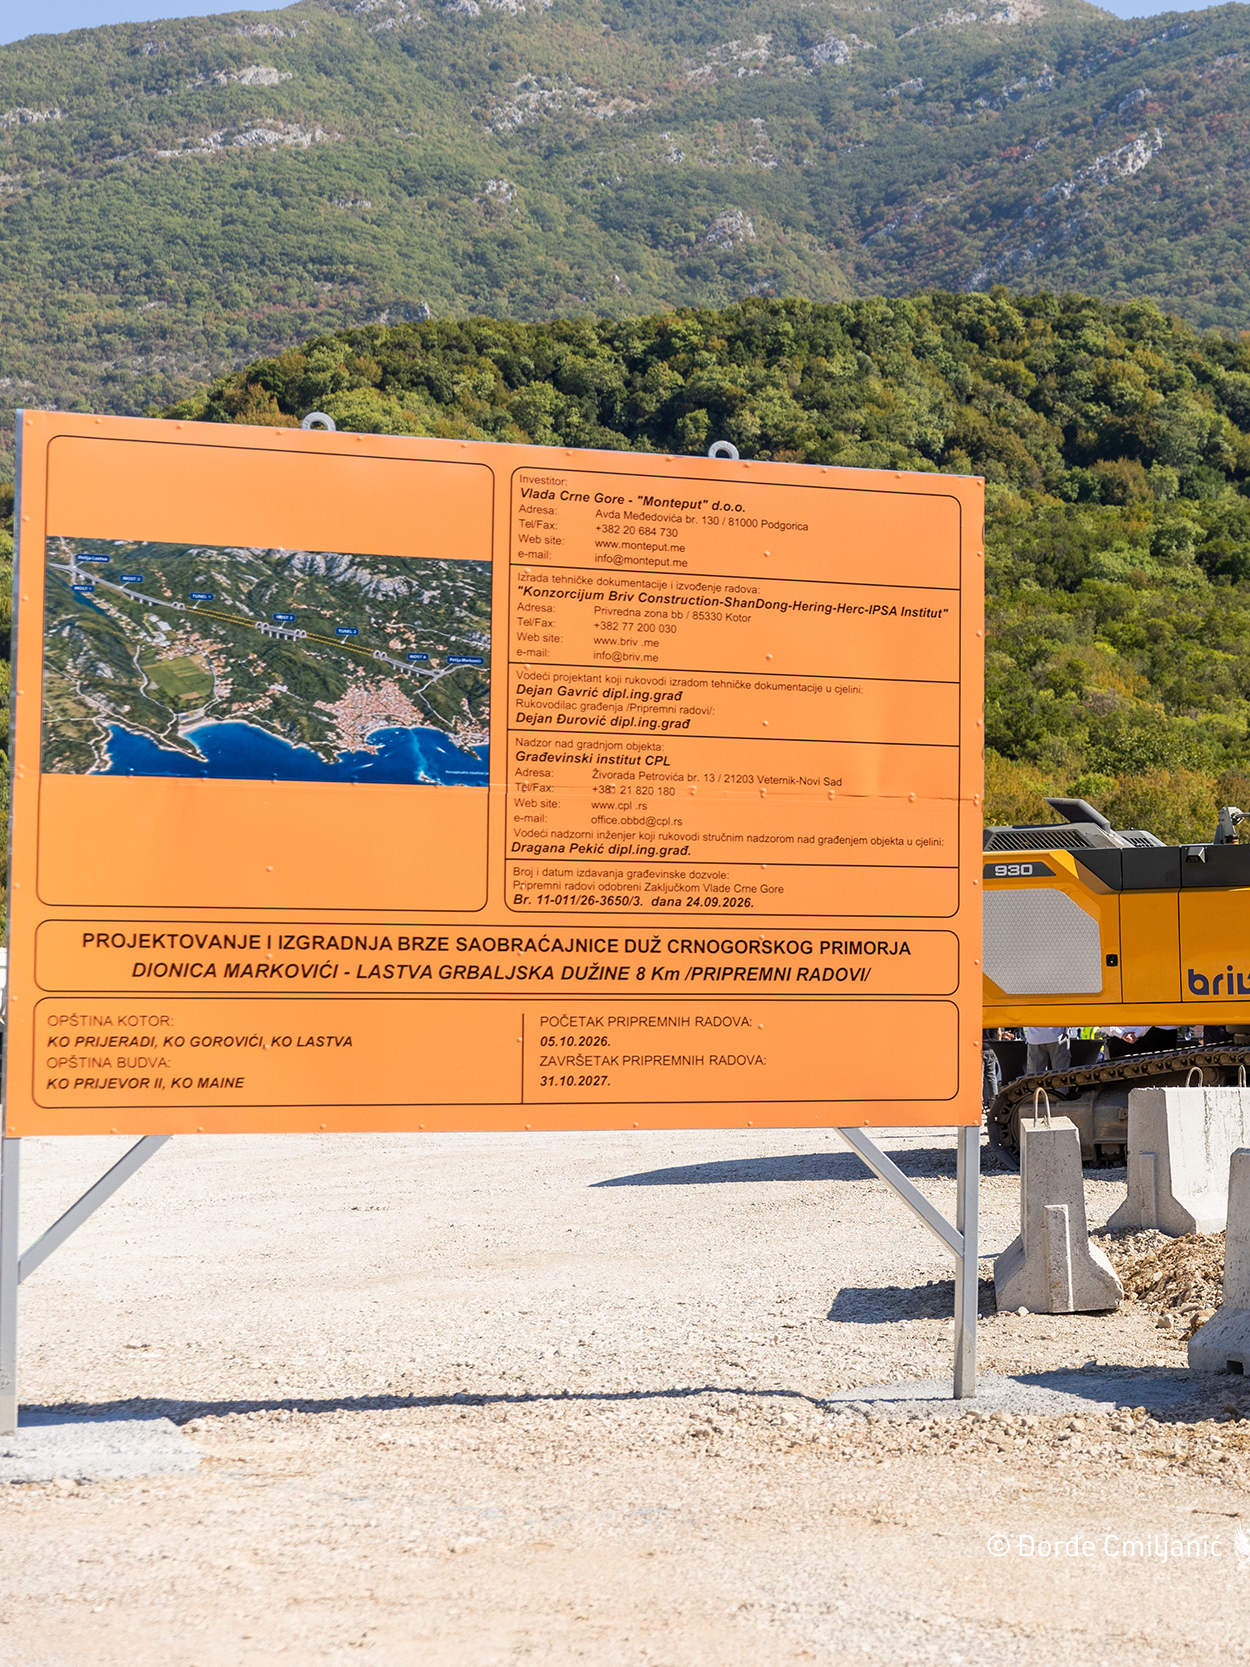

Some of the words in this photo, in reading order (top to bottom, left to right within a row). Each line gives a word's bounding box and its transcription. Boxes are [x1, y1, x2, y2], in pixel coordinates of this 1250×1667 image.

[519, 473, 567, 486] Investitor:
[520, 487, 555, 500] Vlada
[559, 489, 590, 503] Crne
[593, 492, 625, 505] Gore
[637, 494, 708, 511] "Monteput"
[711, 500, 745, 512] d.o.o.
[518, 503, 557, 515] Adresa:
[594, 508, 620, 519] Avda
[623, 510, 682, 523] Međedovića
[685, 514, 698, 524] br.
[701, 515, 720, 526] 130
[721, 516, 726, 526] /
[727, 516, 758, 528] 81000
[760, 518, 808, 532] Podgorica
[518, 518, 557, 530] Tel/Fax:
[595, 523, 620, 534] +382
[622, 524, 636, 535] 20
[637, 525, 656, 536] 684
[659, 526, 678, 538] 730
[517, 533, 542, 544] Web
[543, 536, 564, 546] site:
[594, 540, 685, 553] www.monteput.me
[517, 550, 551, 559] e-mail:
[594, 553, 688, 568] info@monteput.me
[517, 585, 604, 602] "Konzorcijum
[607, 590, 634, 602] Briv
[637, 591, 897, 616] Construction-ShanDong-Hering-Herc-IPSA
[900, 605, 949, 618] Institut"
[593, 605, 641, 617] Privredna
[643, 609, 668, 619] zona
[670, 609, 684, 620] bb
[685, 610, 690, 619] /
[691, 610, 722, 622] 85330
[724, 612, 752, 623] Kotor
[593, 620, 619, 631] +382
[621, 621, 634, 631] 77
[636, 622, 656, 633] 200
[658, 623, 677, 634] 030
[592, 636, 638, 646] www.briv
[641, 639, 659, 648] .me
[592, 650, 659, 663] info@briv.me
[515, 683, 553, 698] Dejan
[556, 685, 599, 698] Gavrić
[601, 687, 683, 703] dipl.ing.građ
[515, 697, 577, 710] Rukovodilac
[579, 701, 623, 714] građenja
[625, 702, 676, 714] /Pripremni
[679, 705, 715, 715] radovi/:
[515, 711, 553, 726] Dejan
[556, 713, 606, 726] Đurović
[609, 715, 691, 731] dipl.ing.građ
[515, 736, 552, 748] Nadzor
[554, 739, 573, 748] nad
[576, 740, 623, 752] gradnjom
[625, 741, 664, 753] objekta:
[515, 750, 593, 764] Građevinski
[595, 753, 641, 766] institut
[644, 754, 670, 766] CPL
[619, 784, 631, 795] 21
[634, 785, 654, 796] 820
[657, 786, 675, 796] 180
[590, 800, 632, 812] www.cpl
[635, 802, 648, 810] .rs
[590, 814, 683, 828] office.obbd@cpl.rs
[510, 841, 565, 856] Dragana
[568, 842, 604, 854] Pekić
[607, 843, 691, 858] dipl.ing.građ.
[994, 863, 1033, 877] 930
[512, 893, 531, 905] Br.
[536, 893, 643, 906] 11-011/26-3650/3.
[650, 895, 682, 907] dana
[685, 896, 754, 908] 24.09.2026.
[82, 932, 261, 950] PROJEKTOVANJE
[266, 934, 271, 950] I
[278, 934, 393, 951] IZGRADNJA
[397, 935, 449, 951] BRZE
[455, 933, 618, 953] SAOBRAĆAJNICE
[624, 934, 662, 953] DUŽ
[666, 938, 813, 955] CRNOGORSKOG
[819, 940, 911, 955] PRIMORJA
[131, 962, 216, 978] DIONICA
[223, 959, 338, 979] MARKOVIĆI
[355, 963, 432, 979] LASTVA
[438, 964, 554, 980] GRBALJSKA
[560, 961, 630, 980] DUŽINE
[635, 965, 646, 981] 8
[650, 965, 680, 981] Km
[683, 966, 792, 981] /PRIPREMNI
[795, 966, 872, 982] RADOVI/
[47, 1012, 113, 1027] OPŠTINA
[117, 1014, 173, 1027] KOTOR:
[540, 1013, 604, 1027] POČETAK
[607, 1015, 690, 1027] PRIPREMNIH
[694, 1015, 752, 1027] RADOVA:
[46, 1035, 70, 1048] KO
[74, 1035, 157, 1048] PRIJERADI,
[162, 1035, 185, 1047] KO
[189, 1032, 265, 1049] GOROVIĆI,
[270, 1035, 292, 1047] KO
[296, 1035, 352, 1047] LASTVA
[539, 1035, 610, 1047] 05.10.2026.
[46, 1054, 112, 1069] OPŠTINA
[116, 1056, 170, 1069] BUDVA:
[538, 1052, 619, 1067] ZAVRŠETAK
[622, 1054, 704, 1066] PRIPREMNIH
[708, 1054, 766, 1066] RADOVA:
[46, 1077, 69, 1090] KO
[73, 1077, 150, 1089] PRIJEVOR
[153, 1077, 165, 1090] II,
[170, 1076, 193, 1089] KO
[196, 1076, 245, 1088] MAINE
[539, 1074, 610, 1087] 31.10.2027.
